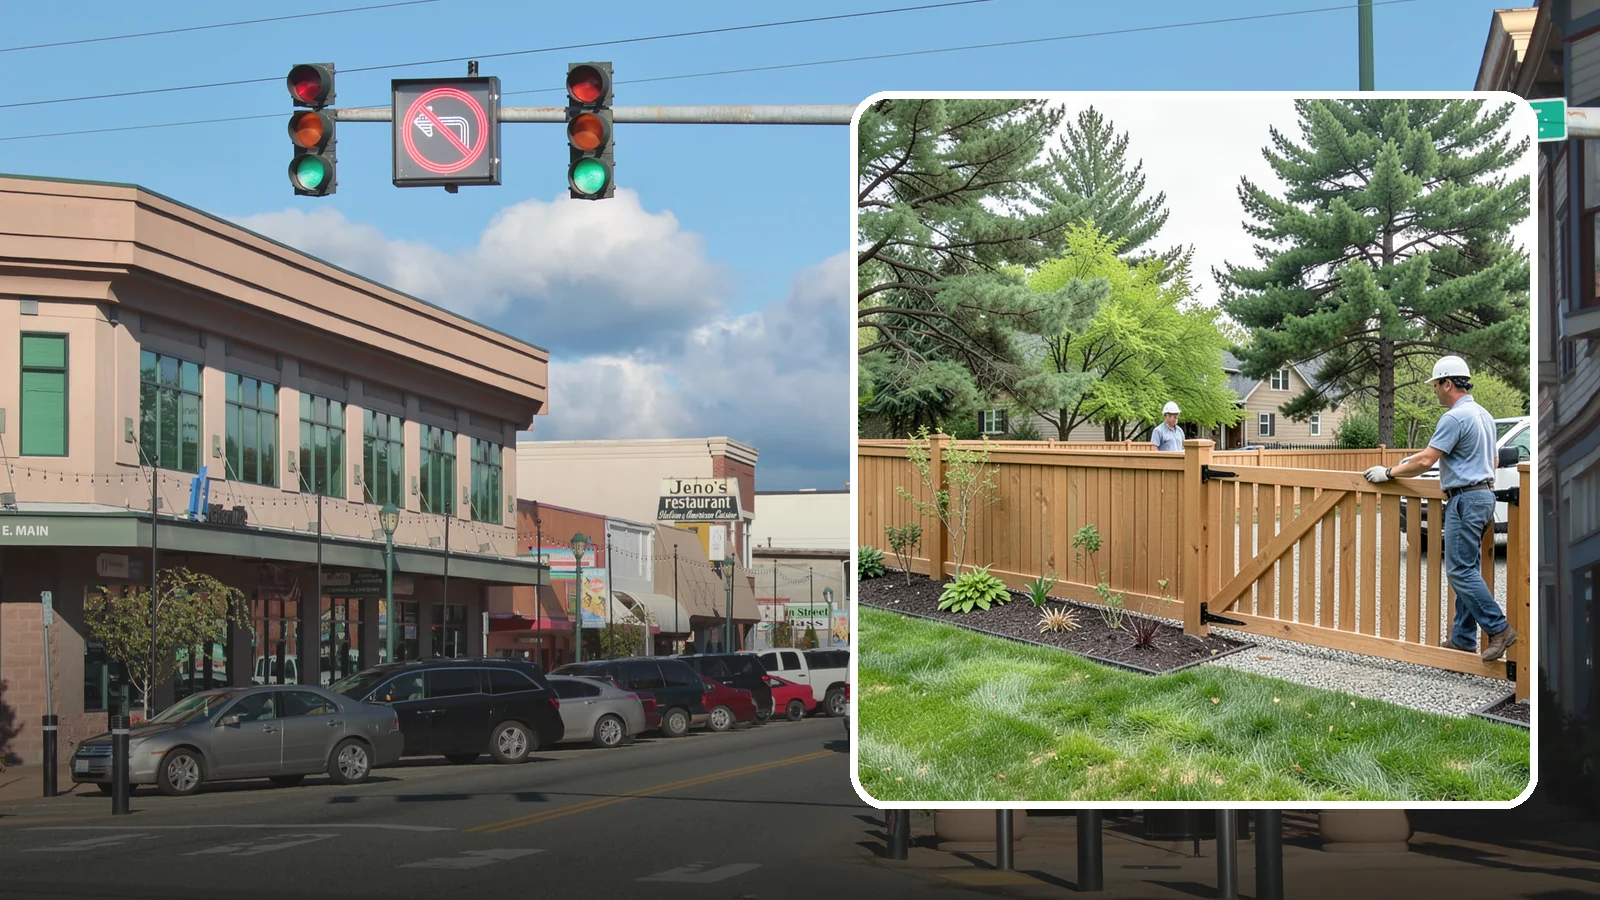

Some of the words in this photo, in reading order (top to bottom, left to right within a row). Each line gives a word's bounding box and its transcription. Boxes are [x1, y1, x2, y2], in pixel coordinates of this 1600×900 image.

[670, 480, 727, 494] Jeno's
[665, 497, 731, 509] restaurant
[658, 510, 682, 519] Italian
[686, 510, 715, 519] American
[715, 510, 737, 519] Cuisine
[2, 525, 13, 536] E.
[15, 525, 49, 536] MAIN
[797, 608, 828, 616] Street
